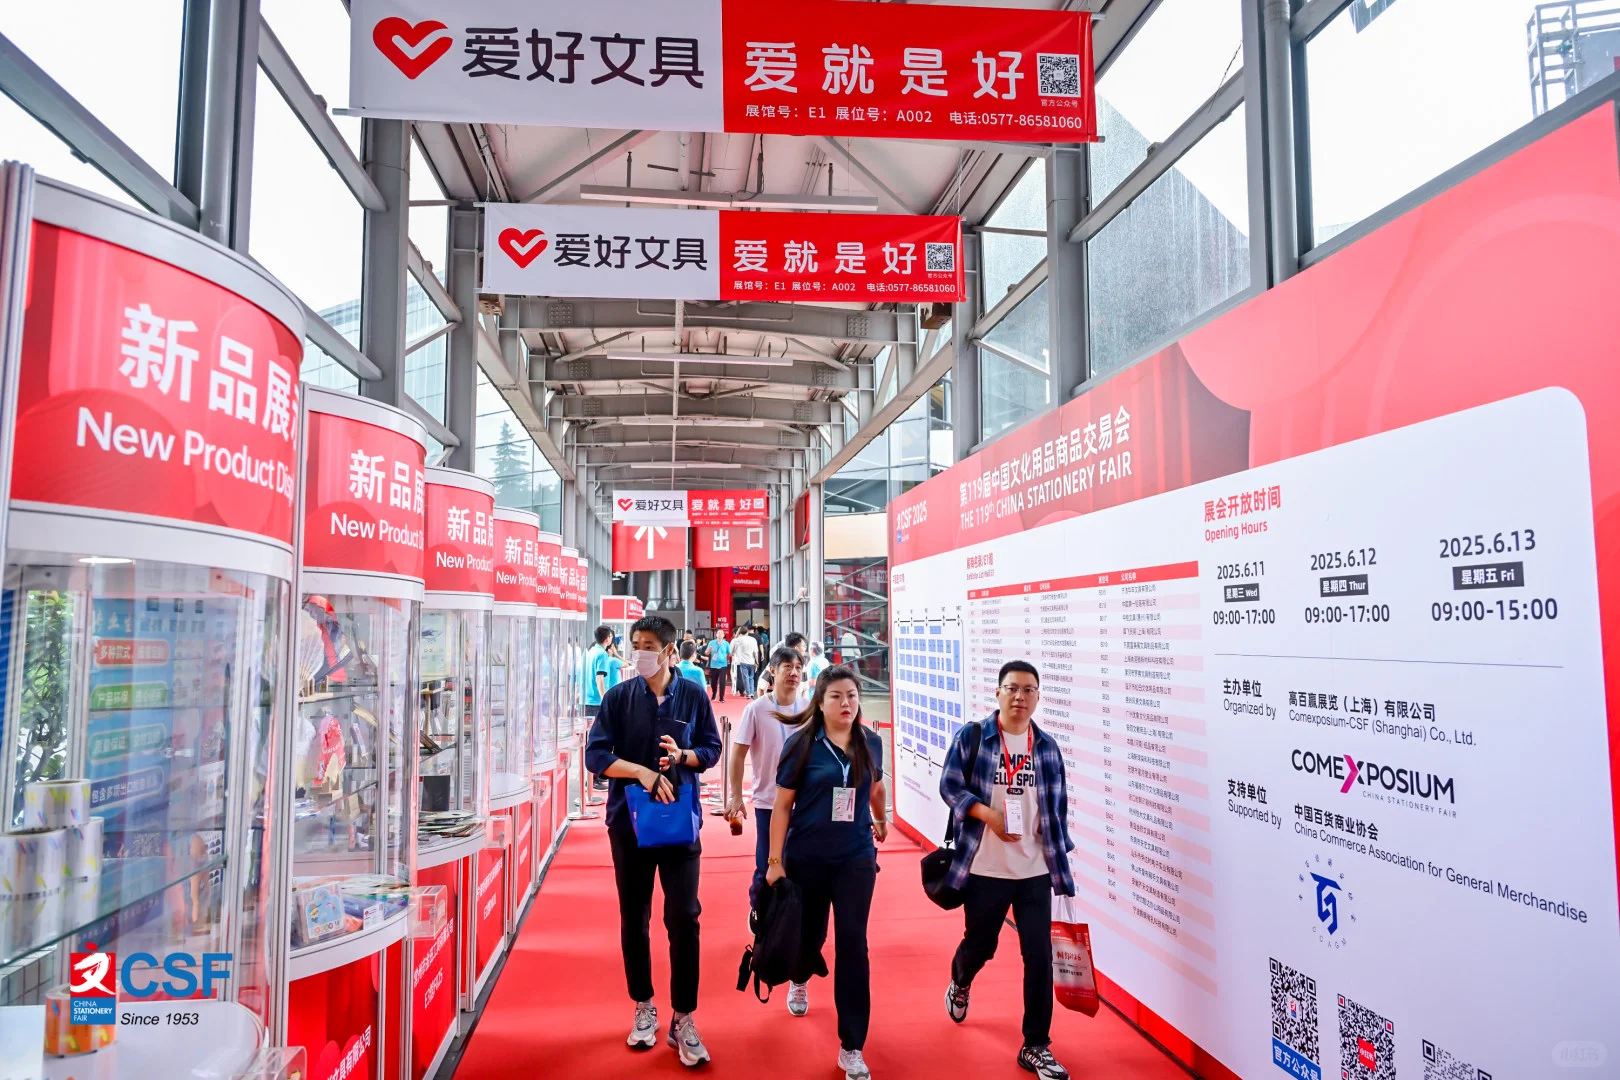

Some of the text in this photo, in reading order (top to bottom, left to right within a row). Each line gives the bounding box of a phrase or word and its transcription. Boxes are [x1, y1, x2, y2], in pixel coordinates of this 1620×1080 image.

[463, 27, 705, 90] 爱好文具
[744, 41, 1024, 100] 爱就是好
[1040, 98, 1079, 108] 官方公众号
[808, 106, 826, 119] E1
[896, 110, 933, 123] A002
[949, 111, 1082, 130] 电话:0577-86581060
[554, 232, 708, 271] 爱好文具
[733, 239, 917, 275] 爱就是好
[774, 282, 786, 290] E1
[832, 283, 856, 291] A002
[866, 283, 955, 293] 电话:0577-86581060
[76, 406, 176, 463] New
[184, 430, 274, 491] Product
[959, 405, 1131, 508] 第119届中国文化用品商品交易会
[960, 510, 974, 531] THE
[996, 491, 1025, 520] CHINA
[1027, 464, 1096, 509] STATIONERY
[1100, 450, 1133, 482] FAIR
[635, 499, 684, 511] 爱好文具
[691, 498, 752, 512] 爱就是好
[1204, 485, 1282, 523] 展会开放时间
[330, 512, 376, 540] New
[379, 519, 419, 549] Product
[712, 527, 764, 552] 出口
[1204, 519, 1268, 543] Opening Hours
[1439, 529, 1536, 559] 2025.6.13
[436, 551, 465, 569] New
[1217, 560, 1266, 580] 2025.6.11
[1310, 548, 1377, 571] 2025.6.12
[496, 571, 517, 585] New
[1322, 579, 1366, 594] 星期四 Thur
[1461, 567, 1515, 586] 星期五 Fri
[1225, 587, 1258, 600] 星期三 Wed
[1213, 608, 1276, 625] 09:00-17:00
[1304, 604, 1390, 624] 09:00-17:00
[1431, 597, 1559, 622] 09:00-15:00
[1223, 678, 1262, 698] 主办单位
[1223, 699, 1277, 721] Organized by
[1288, 710, 1477, 746] Comexposium-CSF (Shanghai) Co., Ltd.
[1291, 749, 1455, 804] COMEXPOSIUM
[1227, 778, 1267, 805] 支持单位
[1227, 798, 1282, 829] Supported by
[1362, 790, 1457, 819] CHINA STATIONERY FAIR
[1294, 803, 1379, 841] 中国百货商业协会
[1294, 821, 1588, 924] China Commerce Association for General Merchandise
